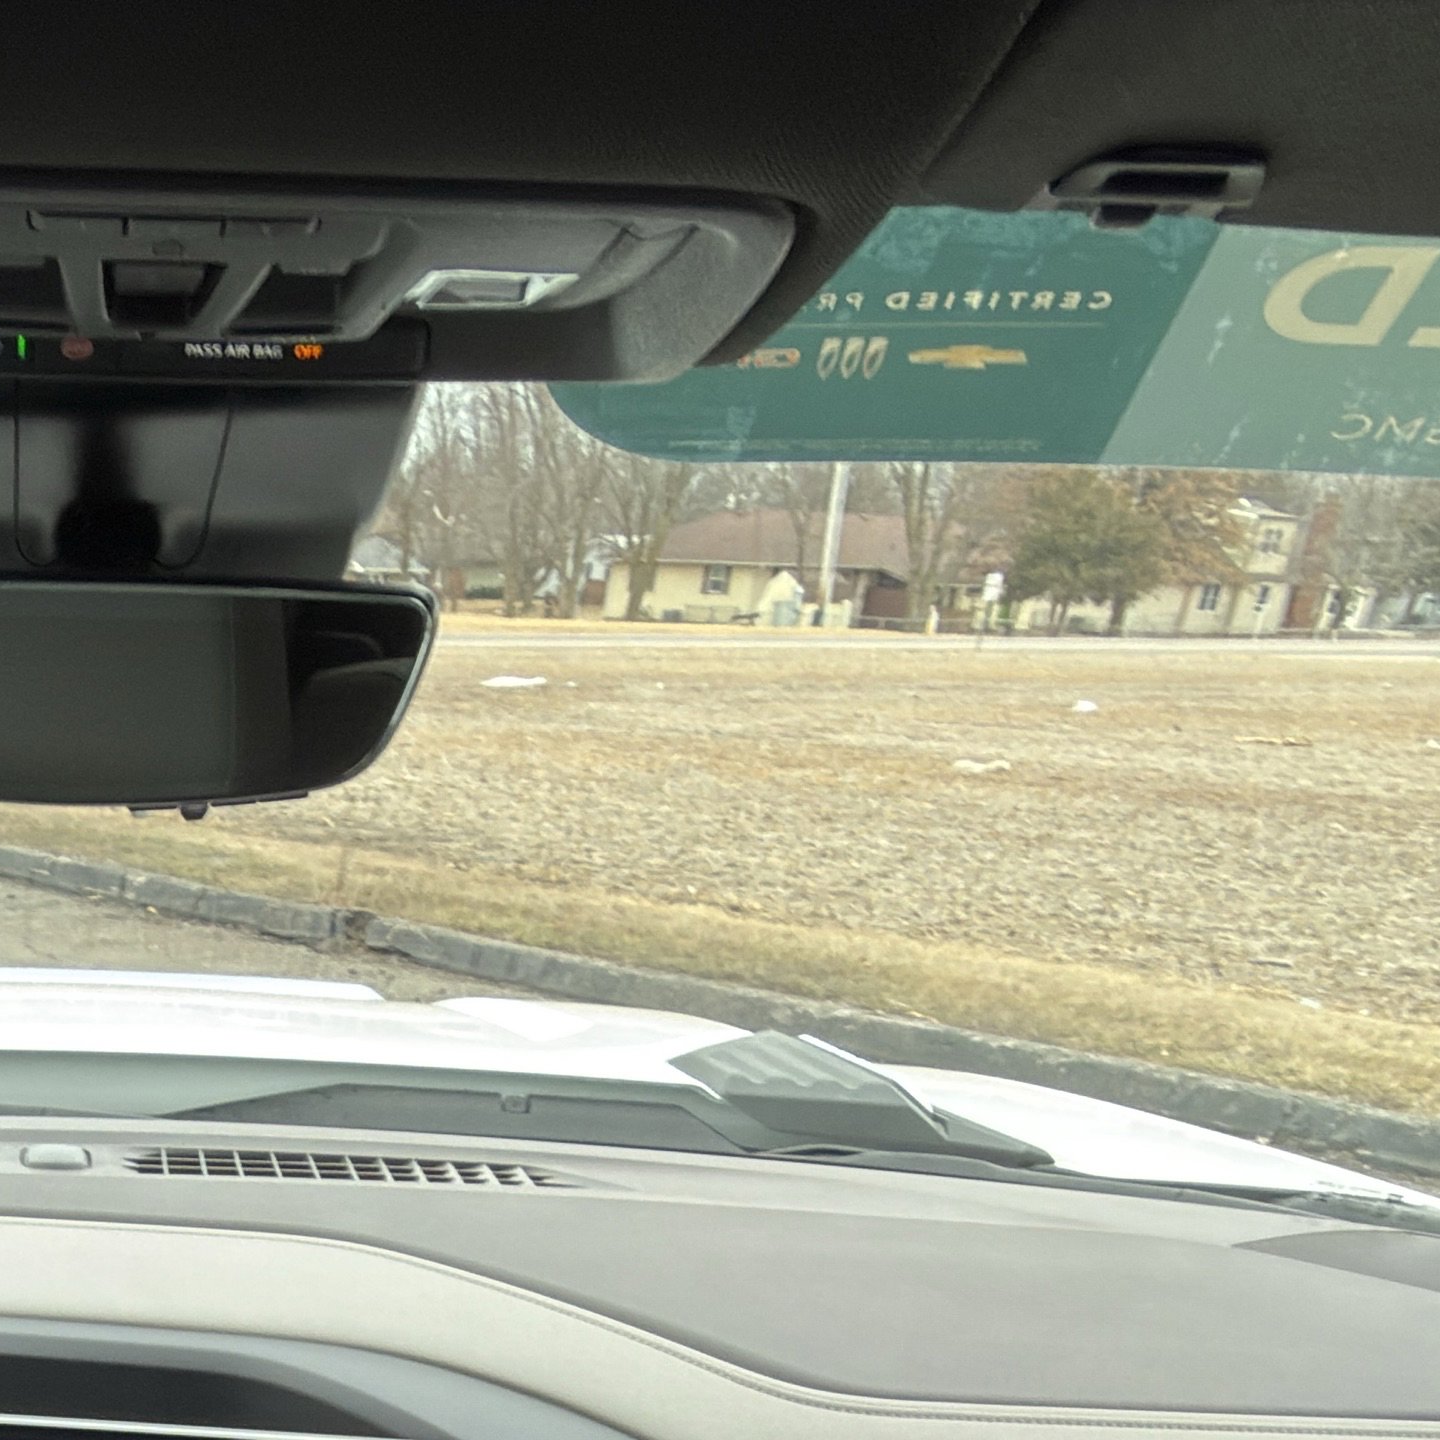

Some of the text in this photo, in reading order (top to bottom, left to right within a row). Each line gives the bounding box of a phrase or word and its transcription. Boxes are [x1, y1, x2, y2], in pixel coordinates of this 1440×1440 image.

[184, 342, 323, 360] PASS AIR BAG OFF
